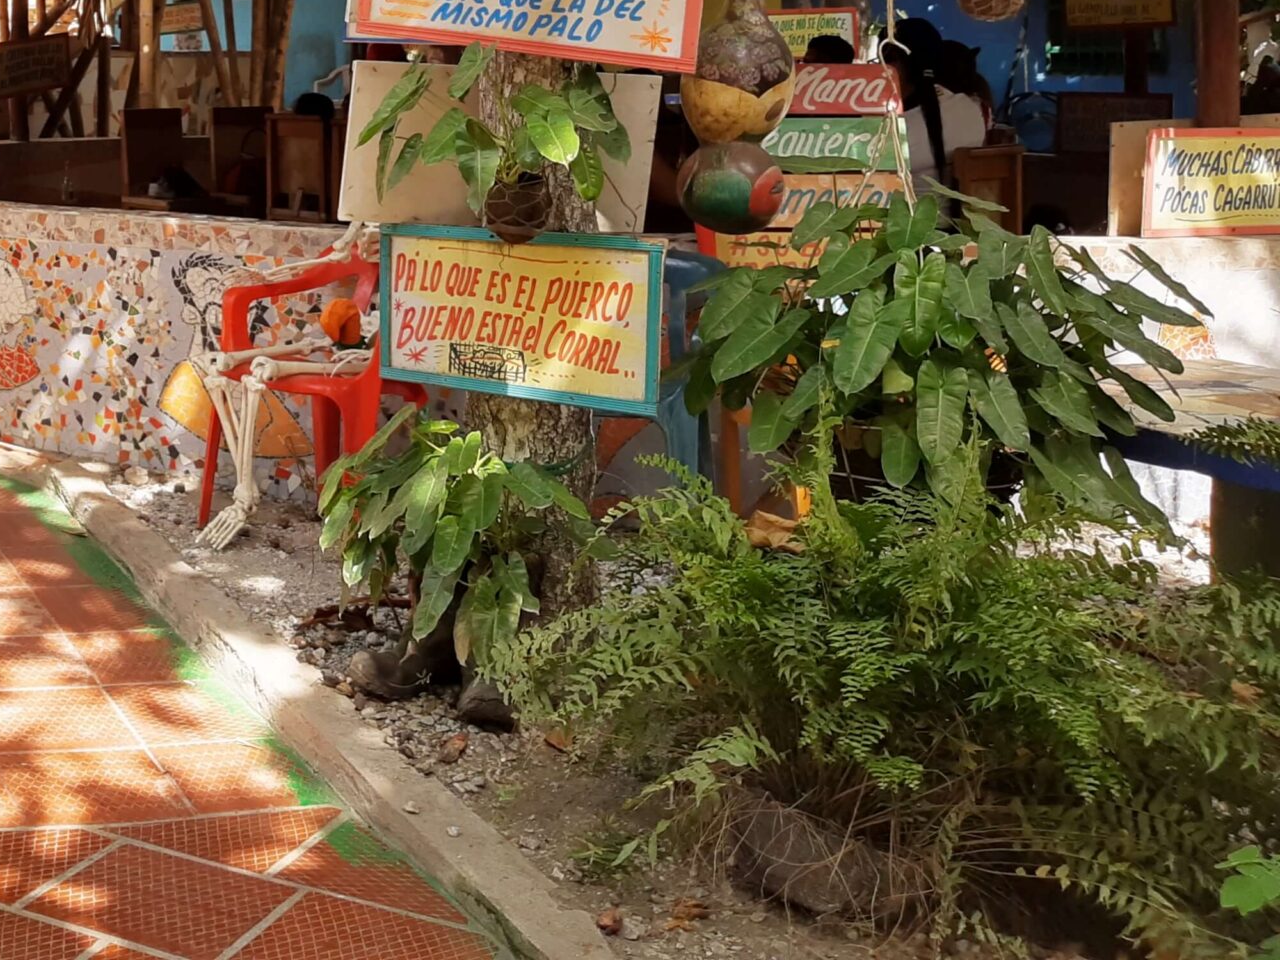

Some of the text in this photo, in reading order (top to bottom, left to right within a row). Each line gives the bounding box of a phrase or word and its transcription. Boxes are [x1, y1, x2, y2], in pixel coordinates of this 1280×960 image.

[431, 2, 603, 42] MISMO PALO
[1162, 147, 1232, 177] MUCHAS
[420, 260, 442, 292] LO
[445, 263, 483, 304] QUE
[485, 270, 511, 304] ES
[513, 275, 537, 311] EL
[396, 305, 475, 349] BUENO
